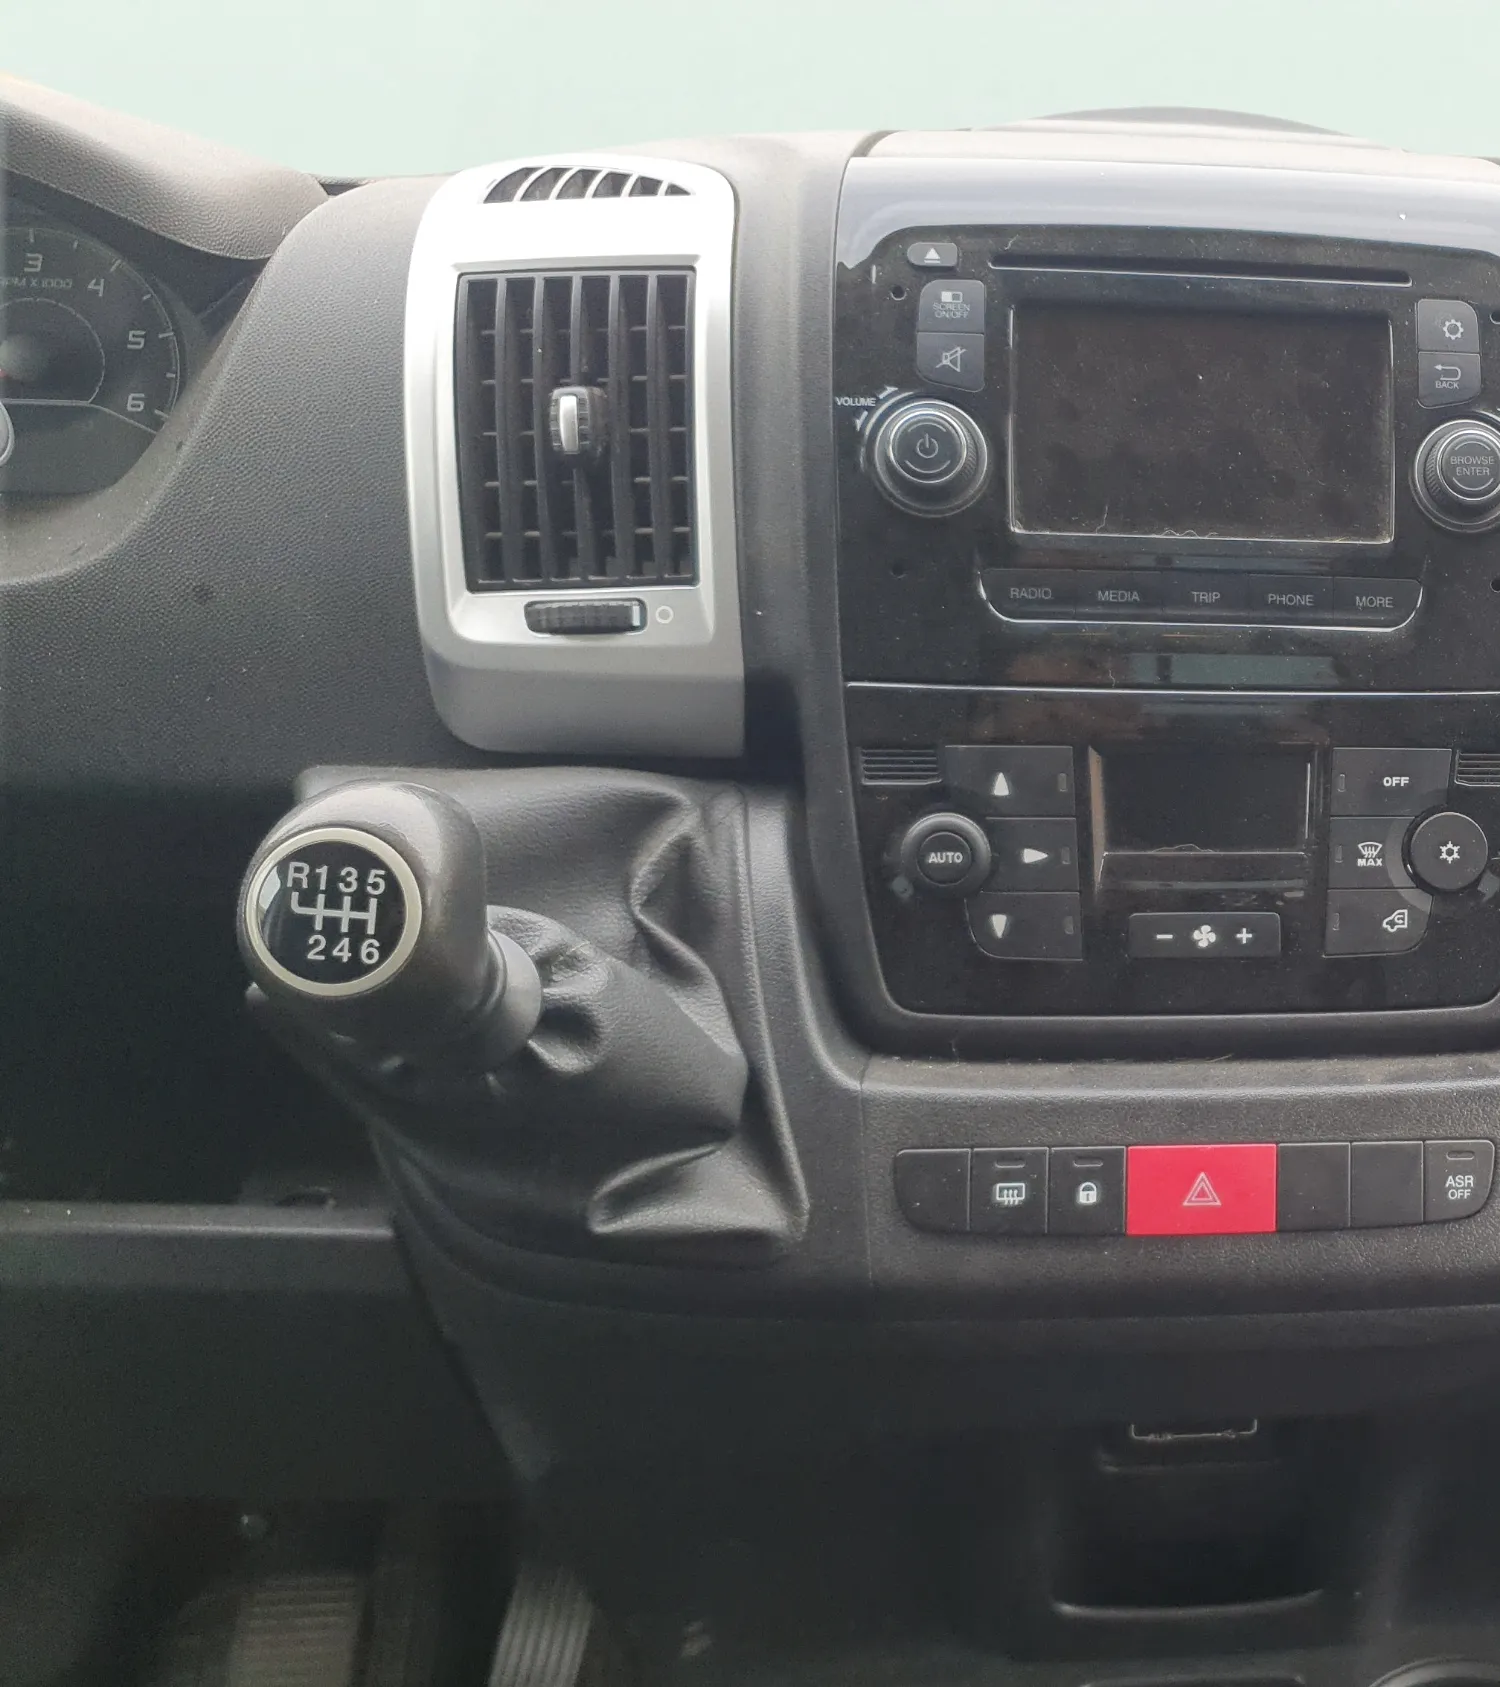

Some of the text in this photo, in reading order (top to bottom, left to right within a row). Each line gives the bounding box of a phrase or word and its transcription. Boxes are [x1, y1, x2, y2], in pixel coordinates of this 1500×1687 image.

[24, 252, 43, 272] 3
[42, 278, 73, 289] 1000
[87, 278, 105, 297] 4
[933, 302, 971, 311] SCREEN
[127, 330, 146, 350] 5
[1435, 381, 1460, 389] BACK
[126, 393, 145, 412] 6
[835, 396, 876, 407] VOLUME
[1450, 455, 1495, 465] BROWSE
[1456, 466, 1490, 476] ENTER
[1010, 587, 1052, 600] RADIO
[1098, 590, 1141, 602] MEDIA
[1191, 591, 1220, 603] TRIP
[1268, 593, 1314, 606] PHONE
[1356, 595, 1394, 608] MORE
[1383, 776, 1410, 787] OFF
[928, 852, 963, 864] AUTO
[1357, 858, 1383, 867] MAX
[1445, 1174, 1474, 1188] ASR
[1448, 1189, 1472, 1200] OFF
